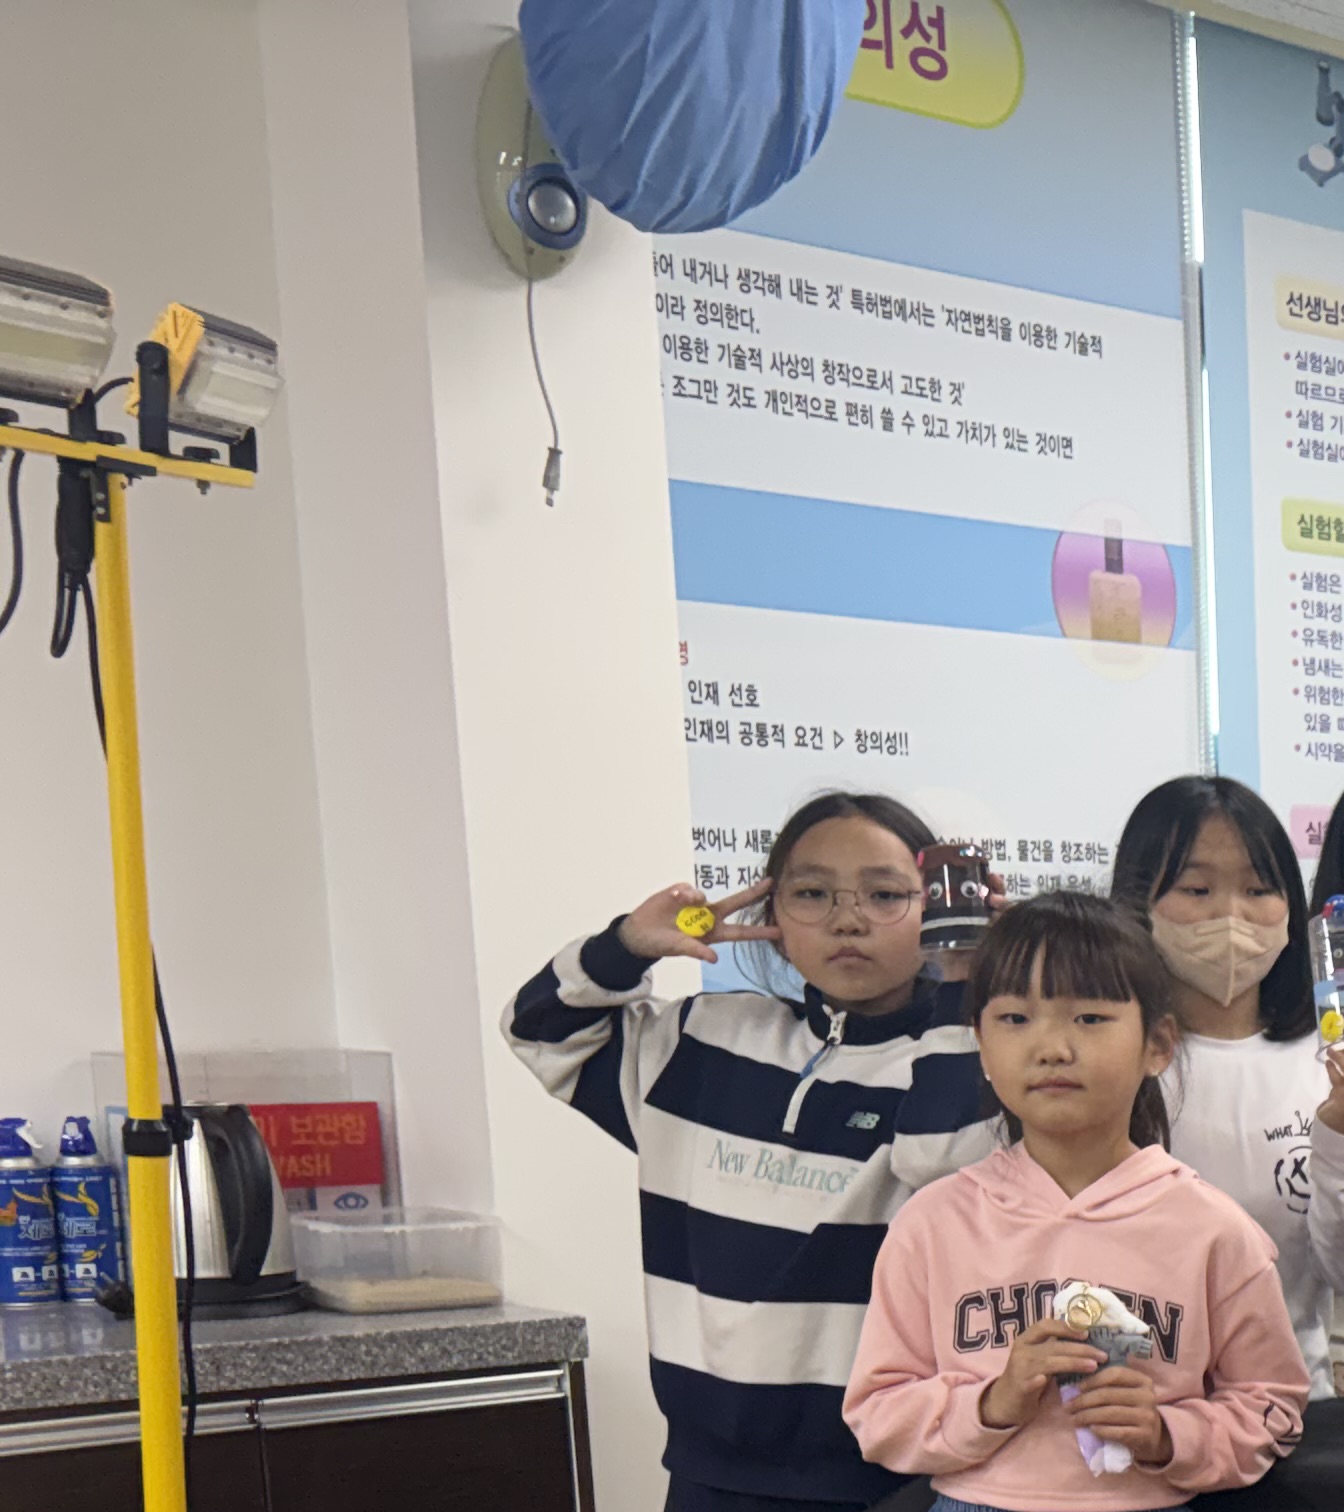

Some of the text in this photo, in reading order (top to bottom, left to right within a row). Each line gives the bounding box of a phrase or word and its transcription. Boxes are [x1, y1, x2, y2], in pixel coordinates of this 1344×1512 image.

[655, 292, 760, 335] 이라 정의한다.
[681, 258, 730, 290] 내거나
[736, 267, 783, 299] 생각해
[789, 278, 819, 307] 내는
[850, 288, 936, 328] 특허법에서는
[1018, 322, 1058, 351] 이용한
[1064, 331, 1103, 359] 기술적
[662, 333, 710, 365] 이용한
[717, 343, 763, 374] 기술적
[769, 351, 815, 382] 사상의
[821, 358, 894, 395] 창작으로서
[900, 375, 943, 403] 고도한
[671, 374, 1073, 460] 조그만 것도 개인적으로 편히 쓸 수 있고 가치가 있는 것이면
[1300, 571, 1342, 595] 실험은
[1300, 599, 1343, 624] 인화성
[1301, 627, 1344, 651] 유독한
[1301, 657, 1344, 679] 냄새는
[687, 679, 761, 708] 인재 선호
[1303, 684, 1344, 707] 위험한
[1303, 712, 1332, 734] 있을
[683, 717, 909, 756] 인재의 공통적 요건 창의성!!
[744, 829, 774, 853] 새롭
[1016, 839, 1054, 863] 물건을
[1060, 841, 1109, 865] 창조하는
[290, 1114, 367, 1145] 보관함
[1264, 1124, 1293, 1142] WHAT
[706, 1138, 750, 1176] New
